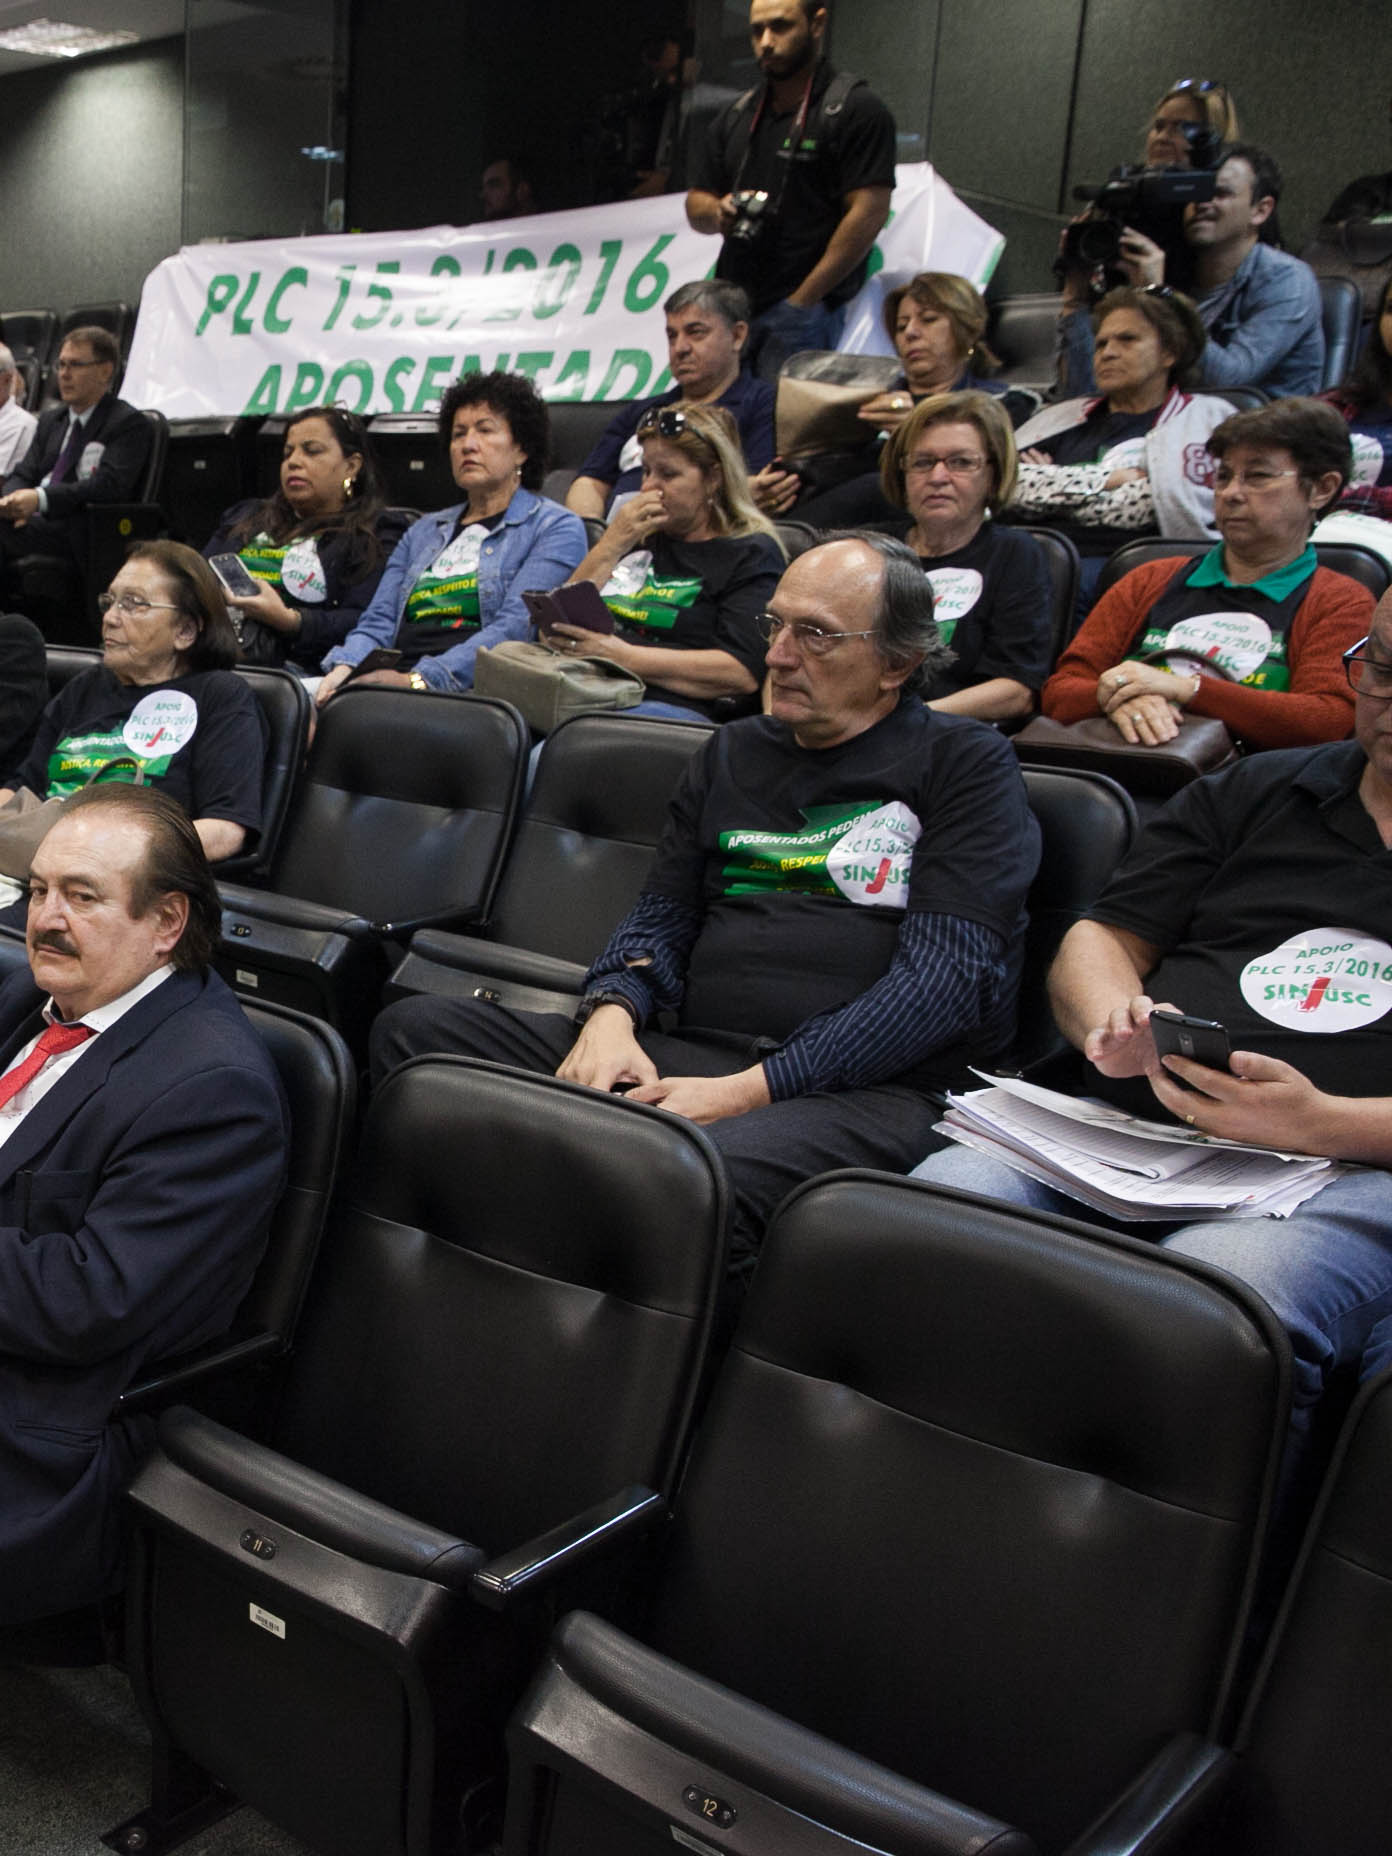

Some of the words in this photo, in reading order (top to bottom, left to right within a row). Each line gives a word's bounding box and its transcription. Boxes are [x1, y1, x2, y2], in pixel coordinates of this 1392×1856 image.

[195, 266, 308, 336] PLC
[727, 831, 826, 849] APOSENTADOS
[1296, 943, 1354, 959] APOIO
[1247, 965, 1286, 975] PLC
[1293, 958, 1392, 982] 15.3/2016
[703, 1798, 718, 1817] 12
